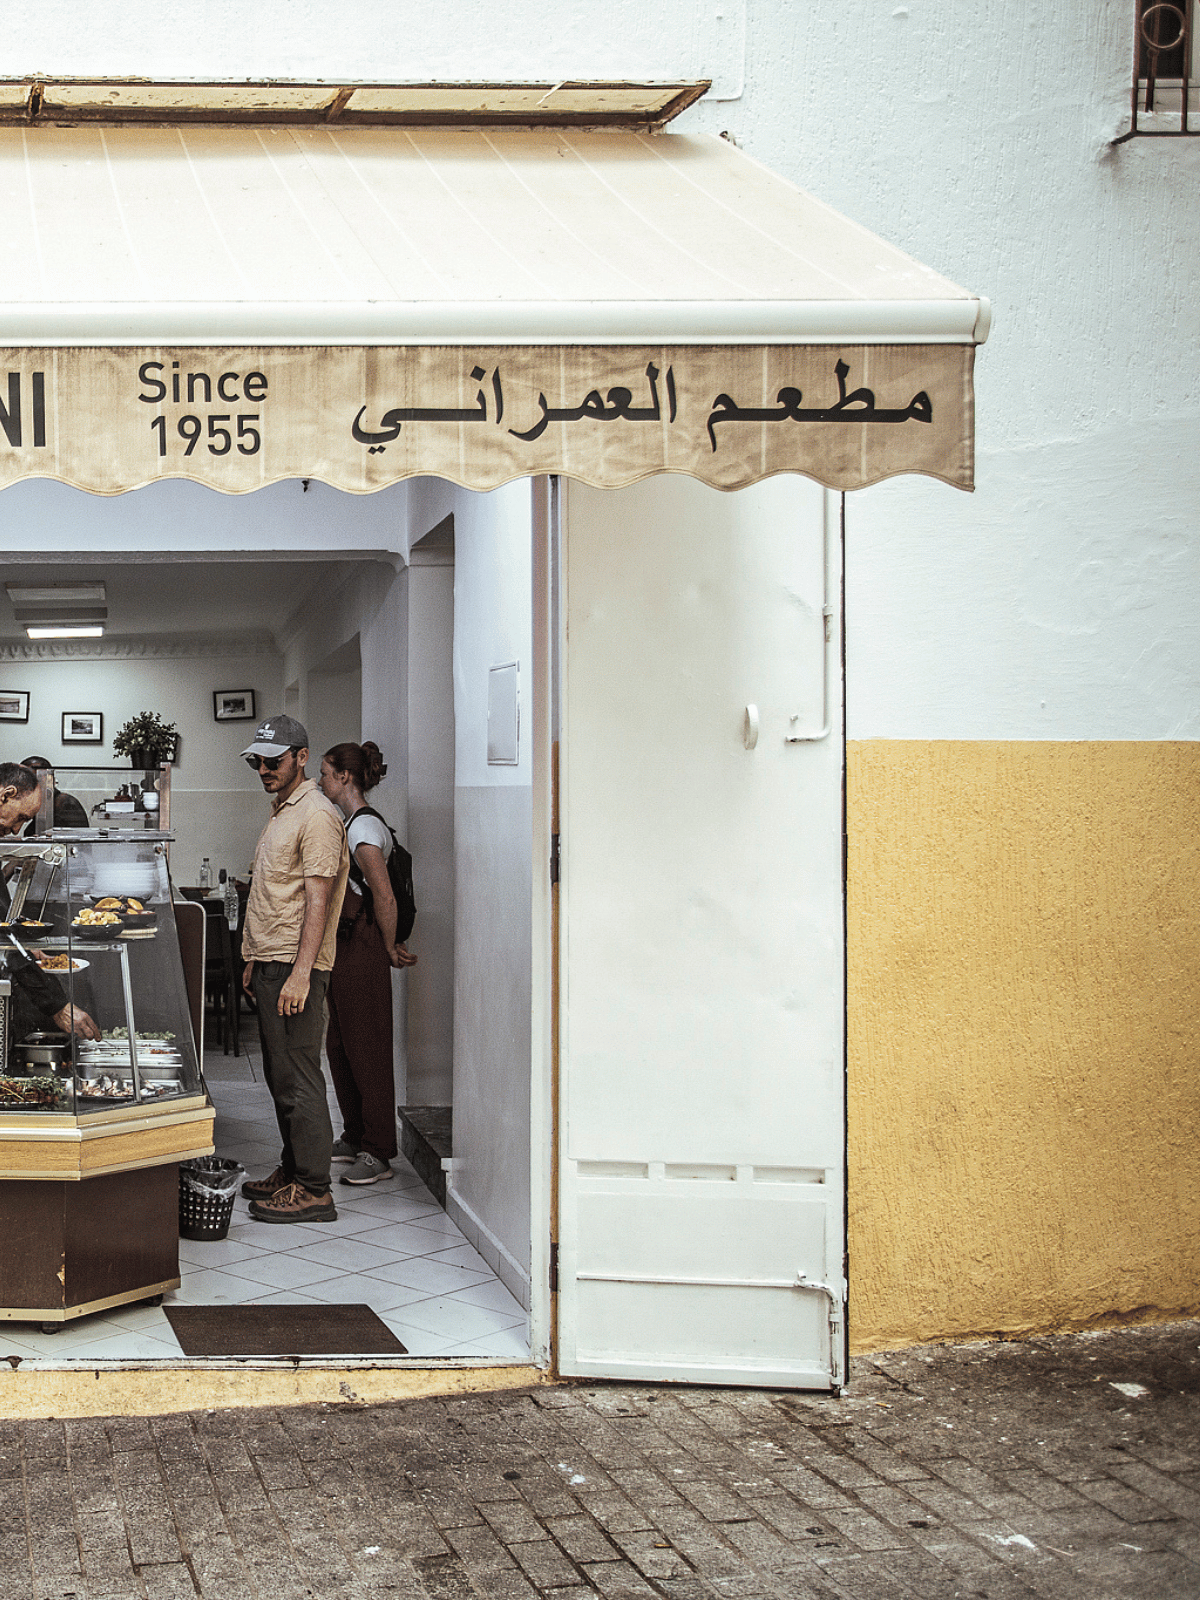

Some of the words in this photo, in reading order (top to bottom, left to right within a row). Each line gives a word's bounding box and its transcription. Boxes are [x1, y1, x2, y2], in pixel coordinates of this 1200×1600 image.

[138, 361, 269, 403] Since
[351, 362, 677, 455] العمراني
[707, 358, 933, 453] مطعم
[151, 415, 262, 457] 1955
